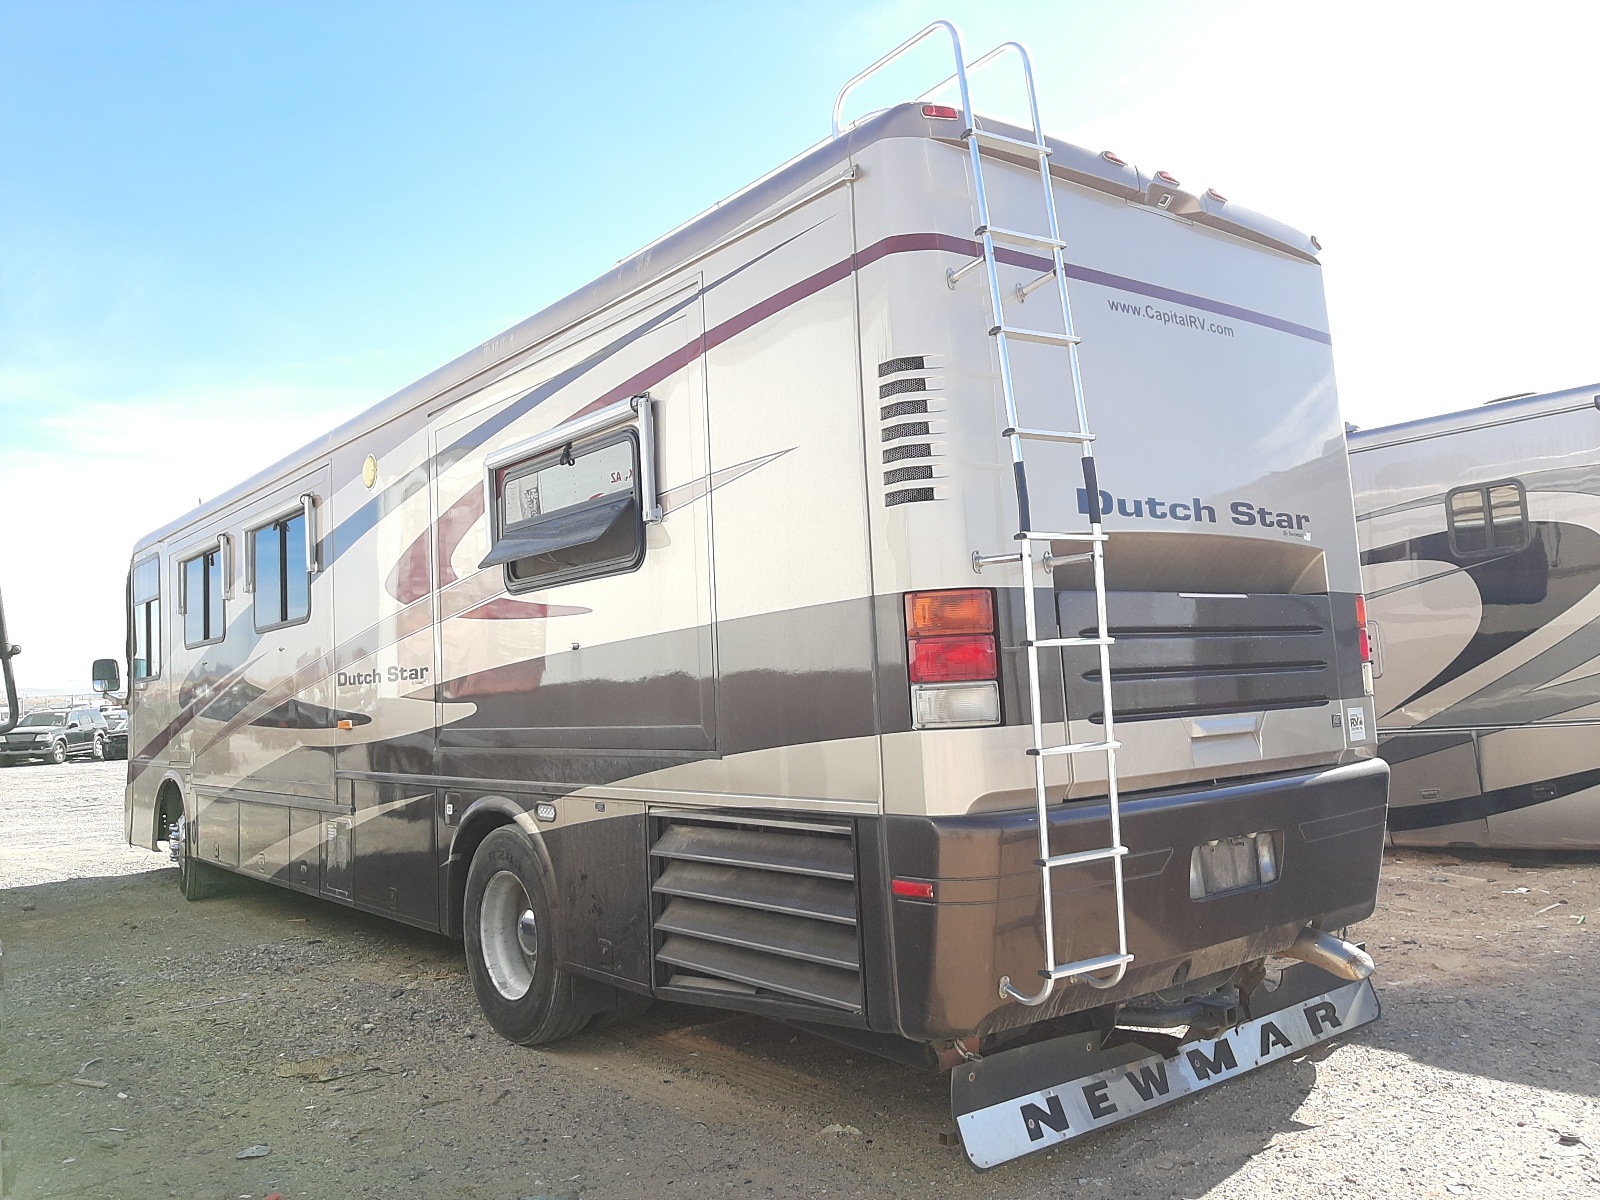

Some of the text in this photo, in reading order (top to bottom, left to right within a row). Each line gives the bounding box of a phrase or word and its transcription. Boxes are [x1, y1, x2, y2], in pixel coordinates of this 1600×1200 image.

[1107, 299, 1235, 338] www.CapitalRV.com
[1076, 487, 1311, 531] Dutch Star
[337, 665, 429, 687] Dutch Star
[1019, 999, 1342, 1142] NEWMAR
